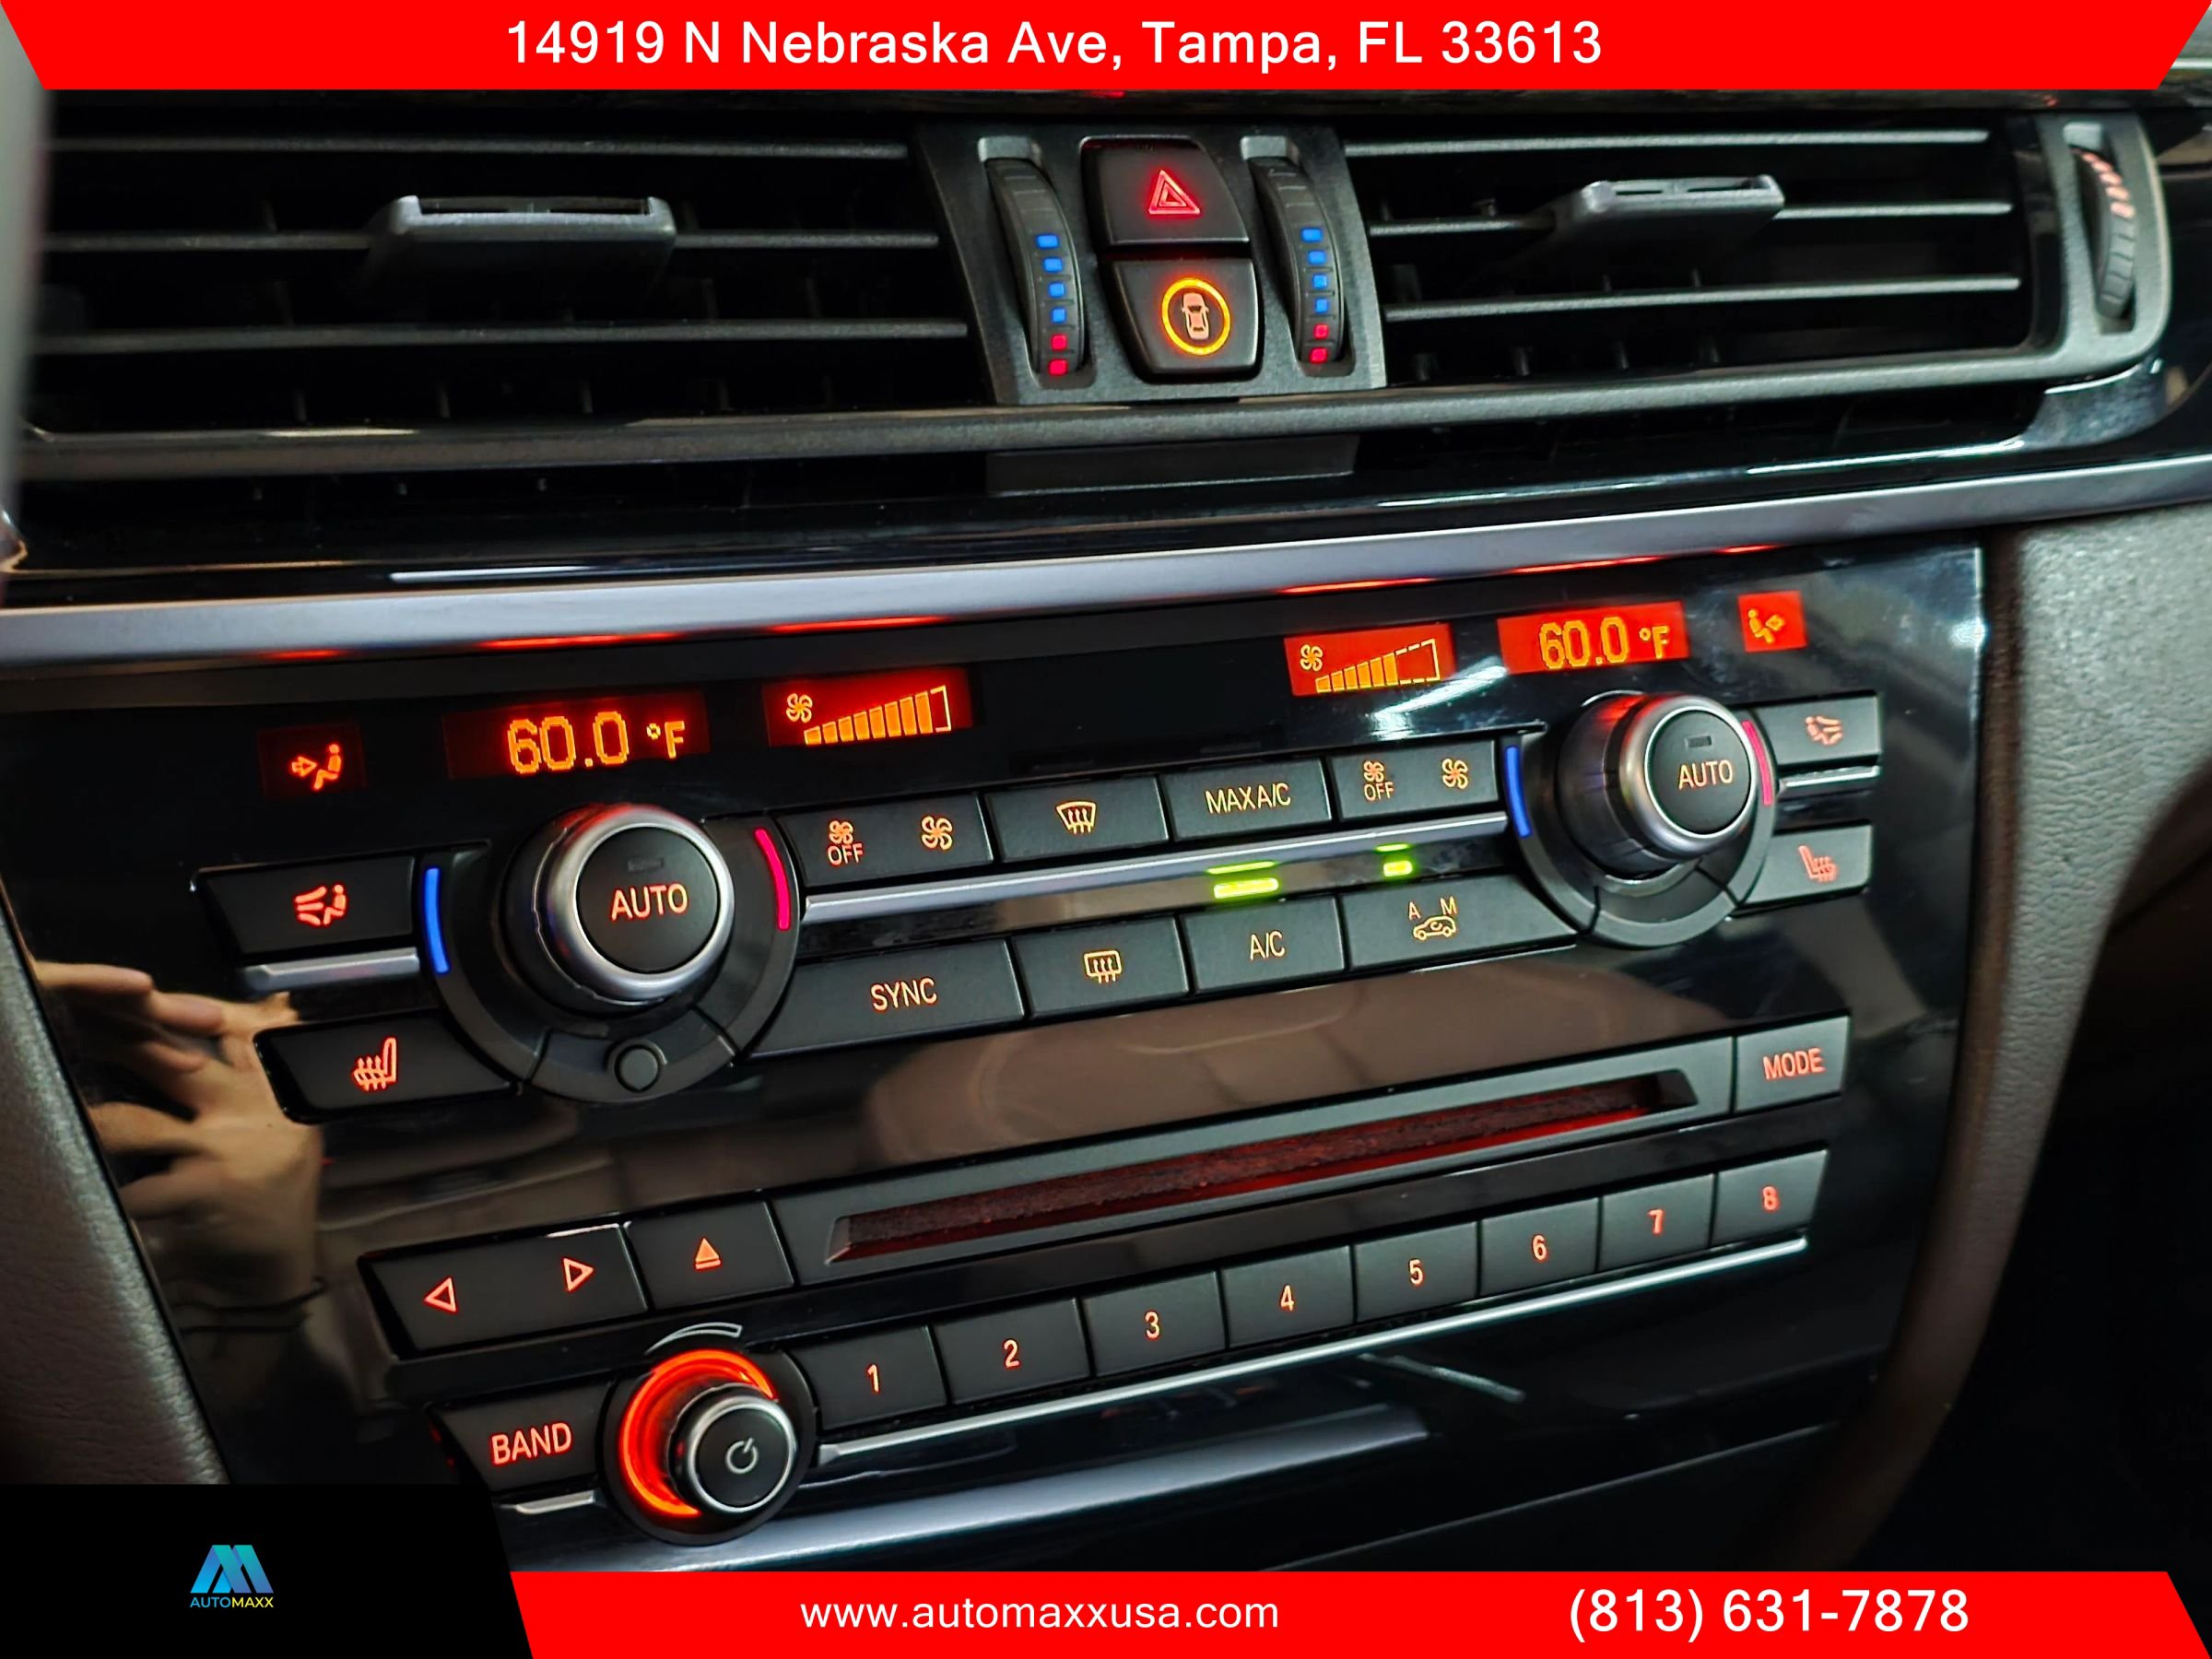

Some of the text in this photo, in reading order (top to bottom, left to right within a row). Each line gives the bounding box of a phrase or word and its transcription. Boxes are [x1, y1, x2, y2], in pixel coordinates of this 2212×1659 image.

[1539, 617, 1629, 669] 60.0
[506, 711, 629, 774] 60.0
[1364, 781, 1394, 802] OFF
[1677, 760, 1735, 790] AUTO
[828, 842, 864, 866] OFF
[610, 882, 688, 921] AUTO
[1407, 896, 1458, 921] A M
[1250, 930, 1287, 960] A/C
[870, 977, 938, 1012] SYNC
[1763, 1047, 1825, 1081] MODE
[867, 1185, 1779, 1394] 1 2 3 4 5 6 7 8
[491, 1421, 572, 1465] BAND
